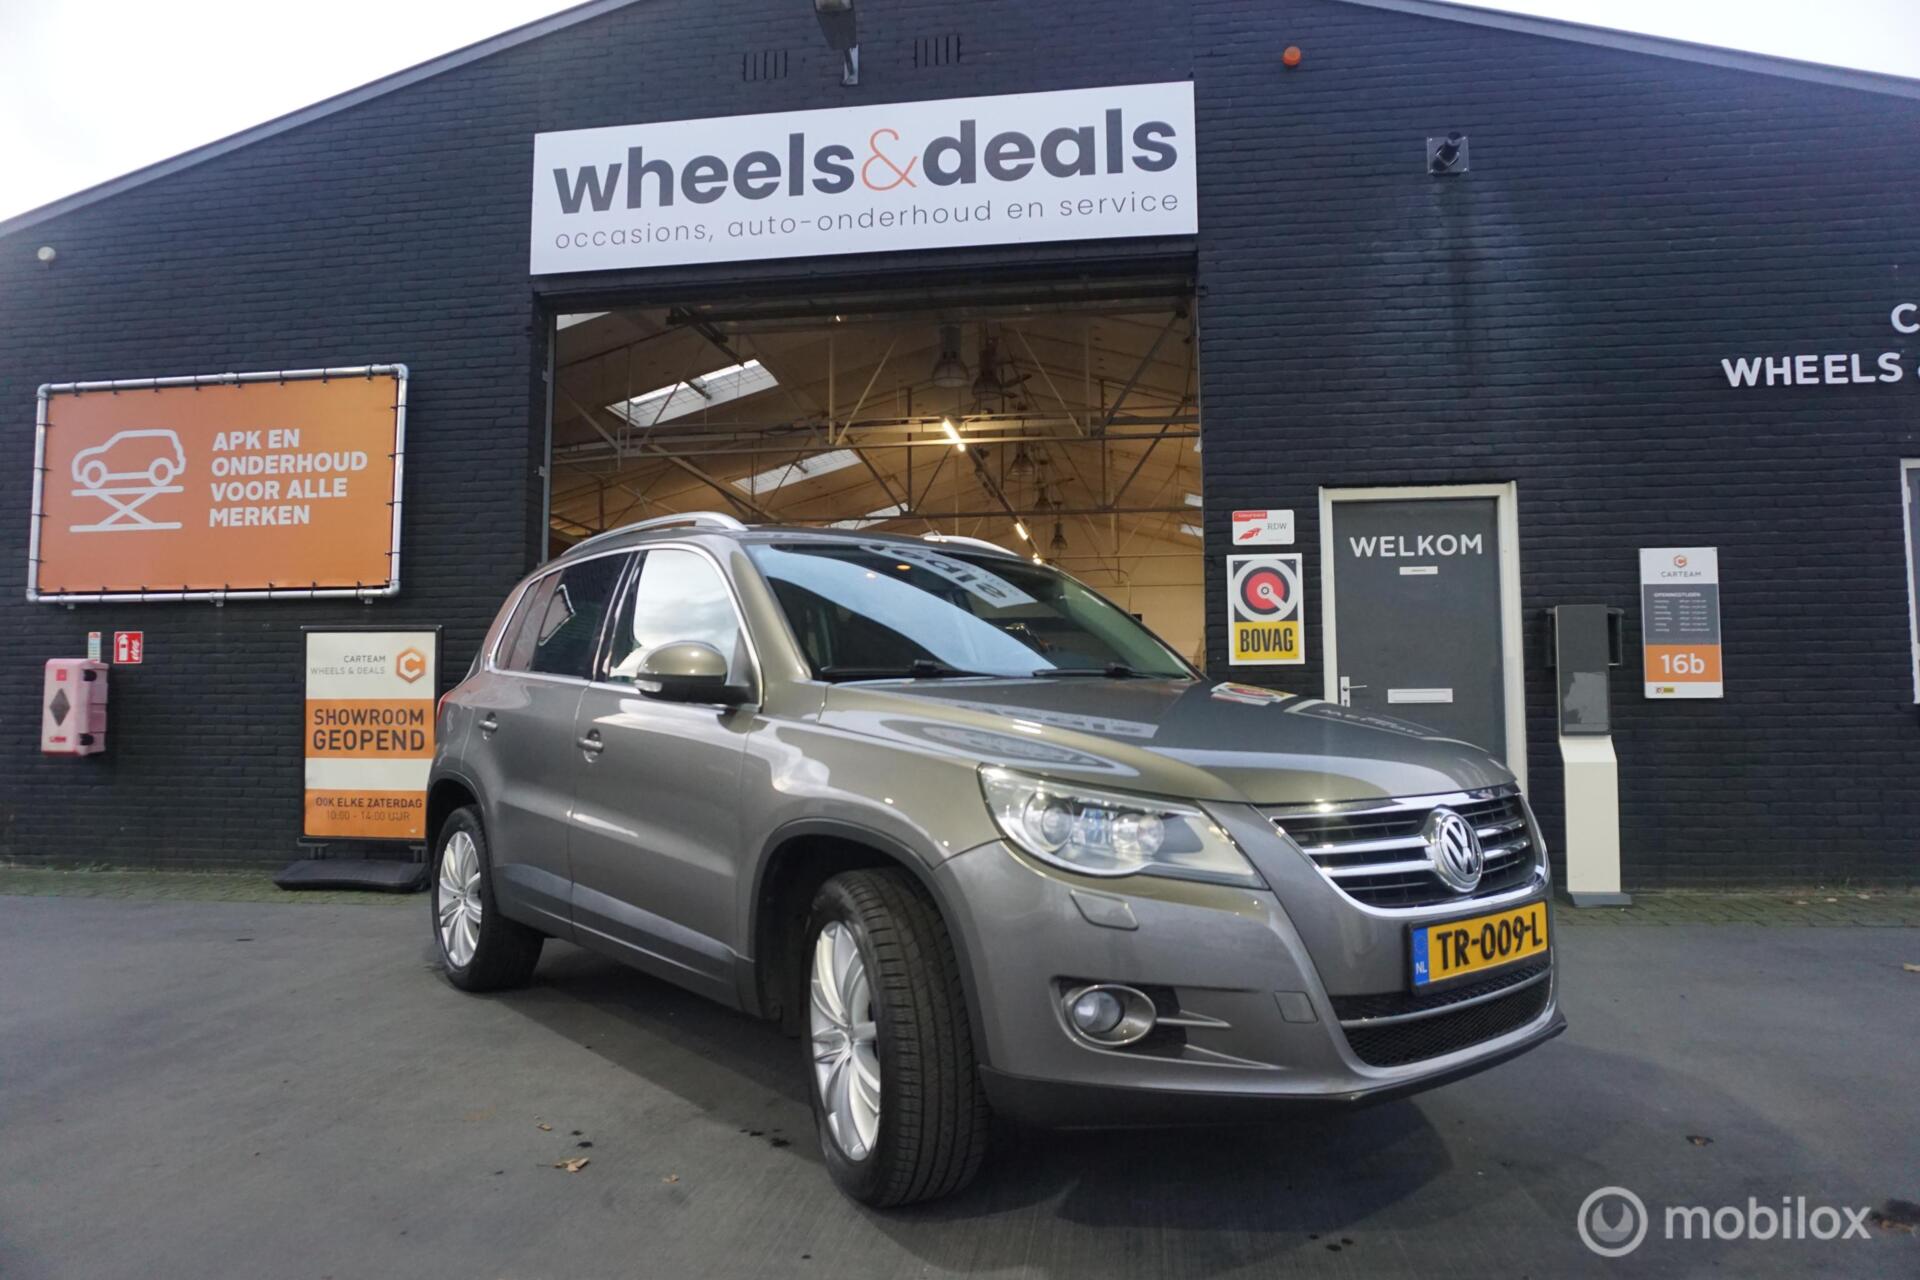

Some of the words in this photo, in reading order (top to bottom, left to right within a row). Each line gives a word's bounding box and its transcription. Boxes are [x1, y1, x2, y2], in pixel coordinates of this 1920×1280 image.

[555, 222, 713, 249] occasions,
[727, 199, 991, 237] auto-onderhoud
[1007, 201, 1043, 219] en
[1060, 192, 1179, 216] service
[1721, 352, 1903, 387] WHEELS
[212, 430, 262, 451] APK
[268, 428, 300, 449] EN
[211, 451, 368, 477] ONDERHOUD
[210, 480, 280, 502] VOOR
[286, 477, 348, 499] ALLE
[209, 504, 310, 527] MERKEN
[1349, 534, 1483, 557] WELKOM
[1240, 628, 1294, 652] BOVAG
[310, 666, 345, 675] WHEELS
[357, 666, 386, 675] DEALS
[343, 655, 386, 663] CARTEAM
[1660, 653, 1705, 674] 16b
[313, 708, 424, 726] SHOWROOM
[313, 729, 425, 751] GEOPEND
[337, 797, 364, 808] ELKE
[367, 798, 423, 809] ZATERDAG
[1436, 911, 1543, 971] TR-009-L
[1415, 960, 1428, 974] NL
